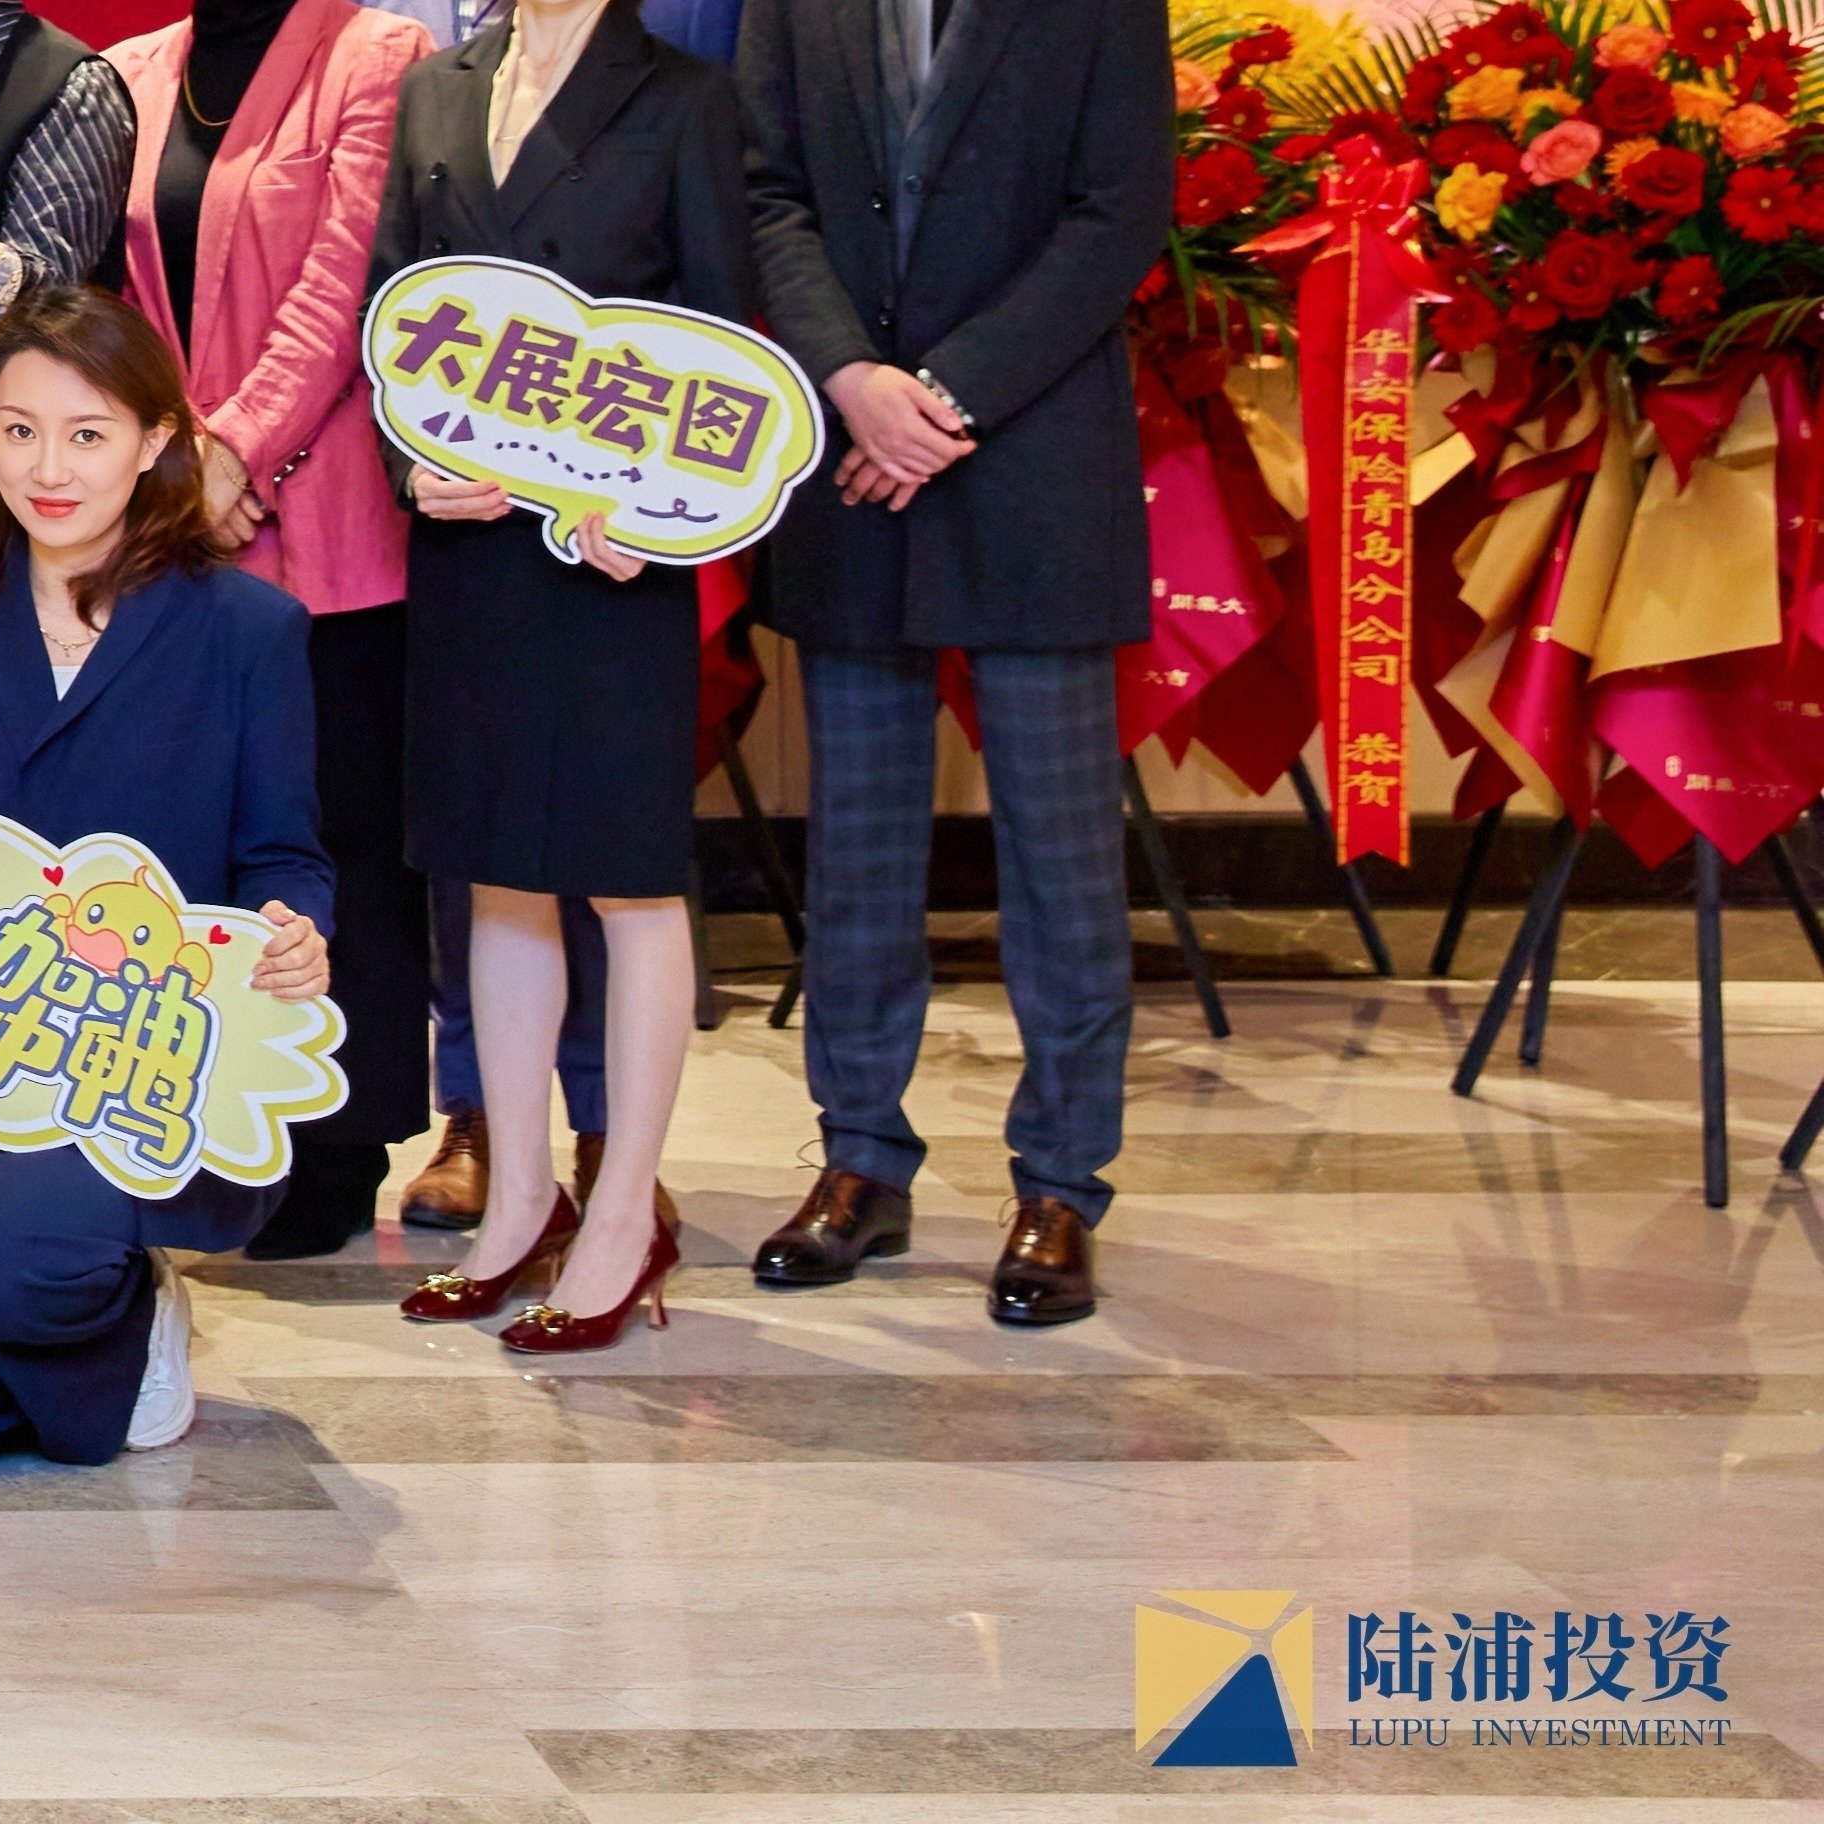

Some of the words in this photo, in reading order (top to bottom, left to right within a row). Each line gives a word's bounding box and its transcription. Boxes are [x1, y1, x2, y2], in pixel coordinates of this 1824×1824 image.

[394, 301, 770, 473] 大展宏图
[1348, 732, 1403, 808] 恭贺
